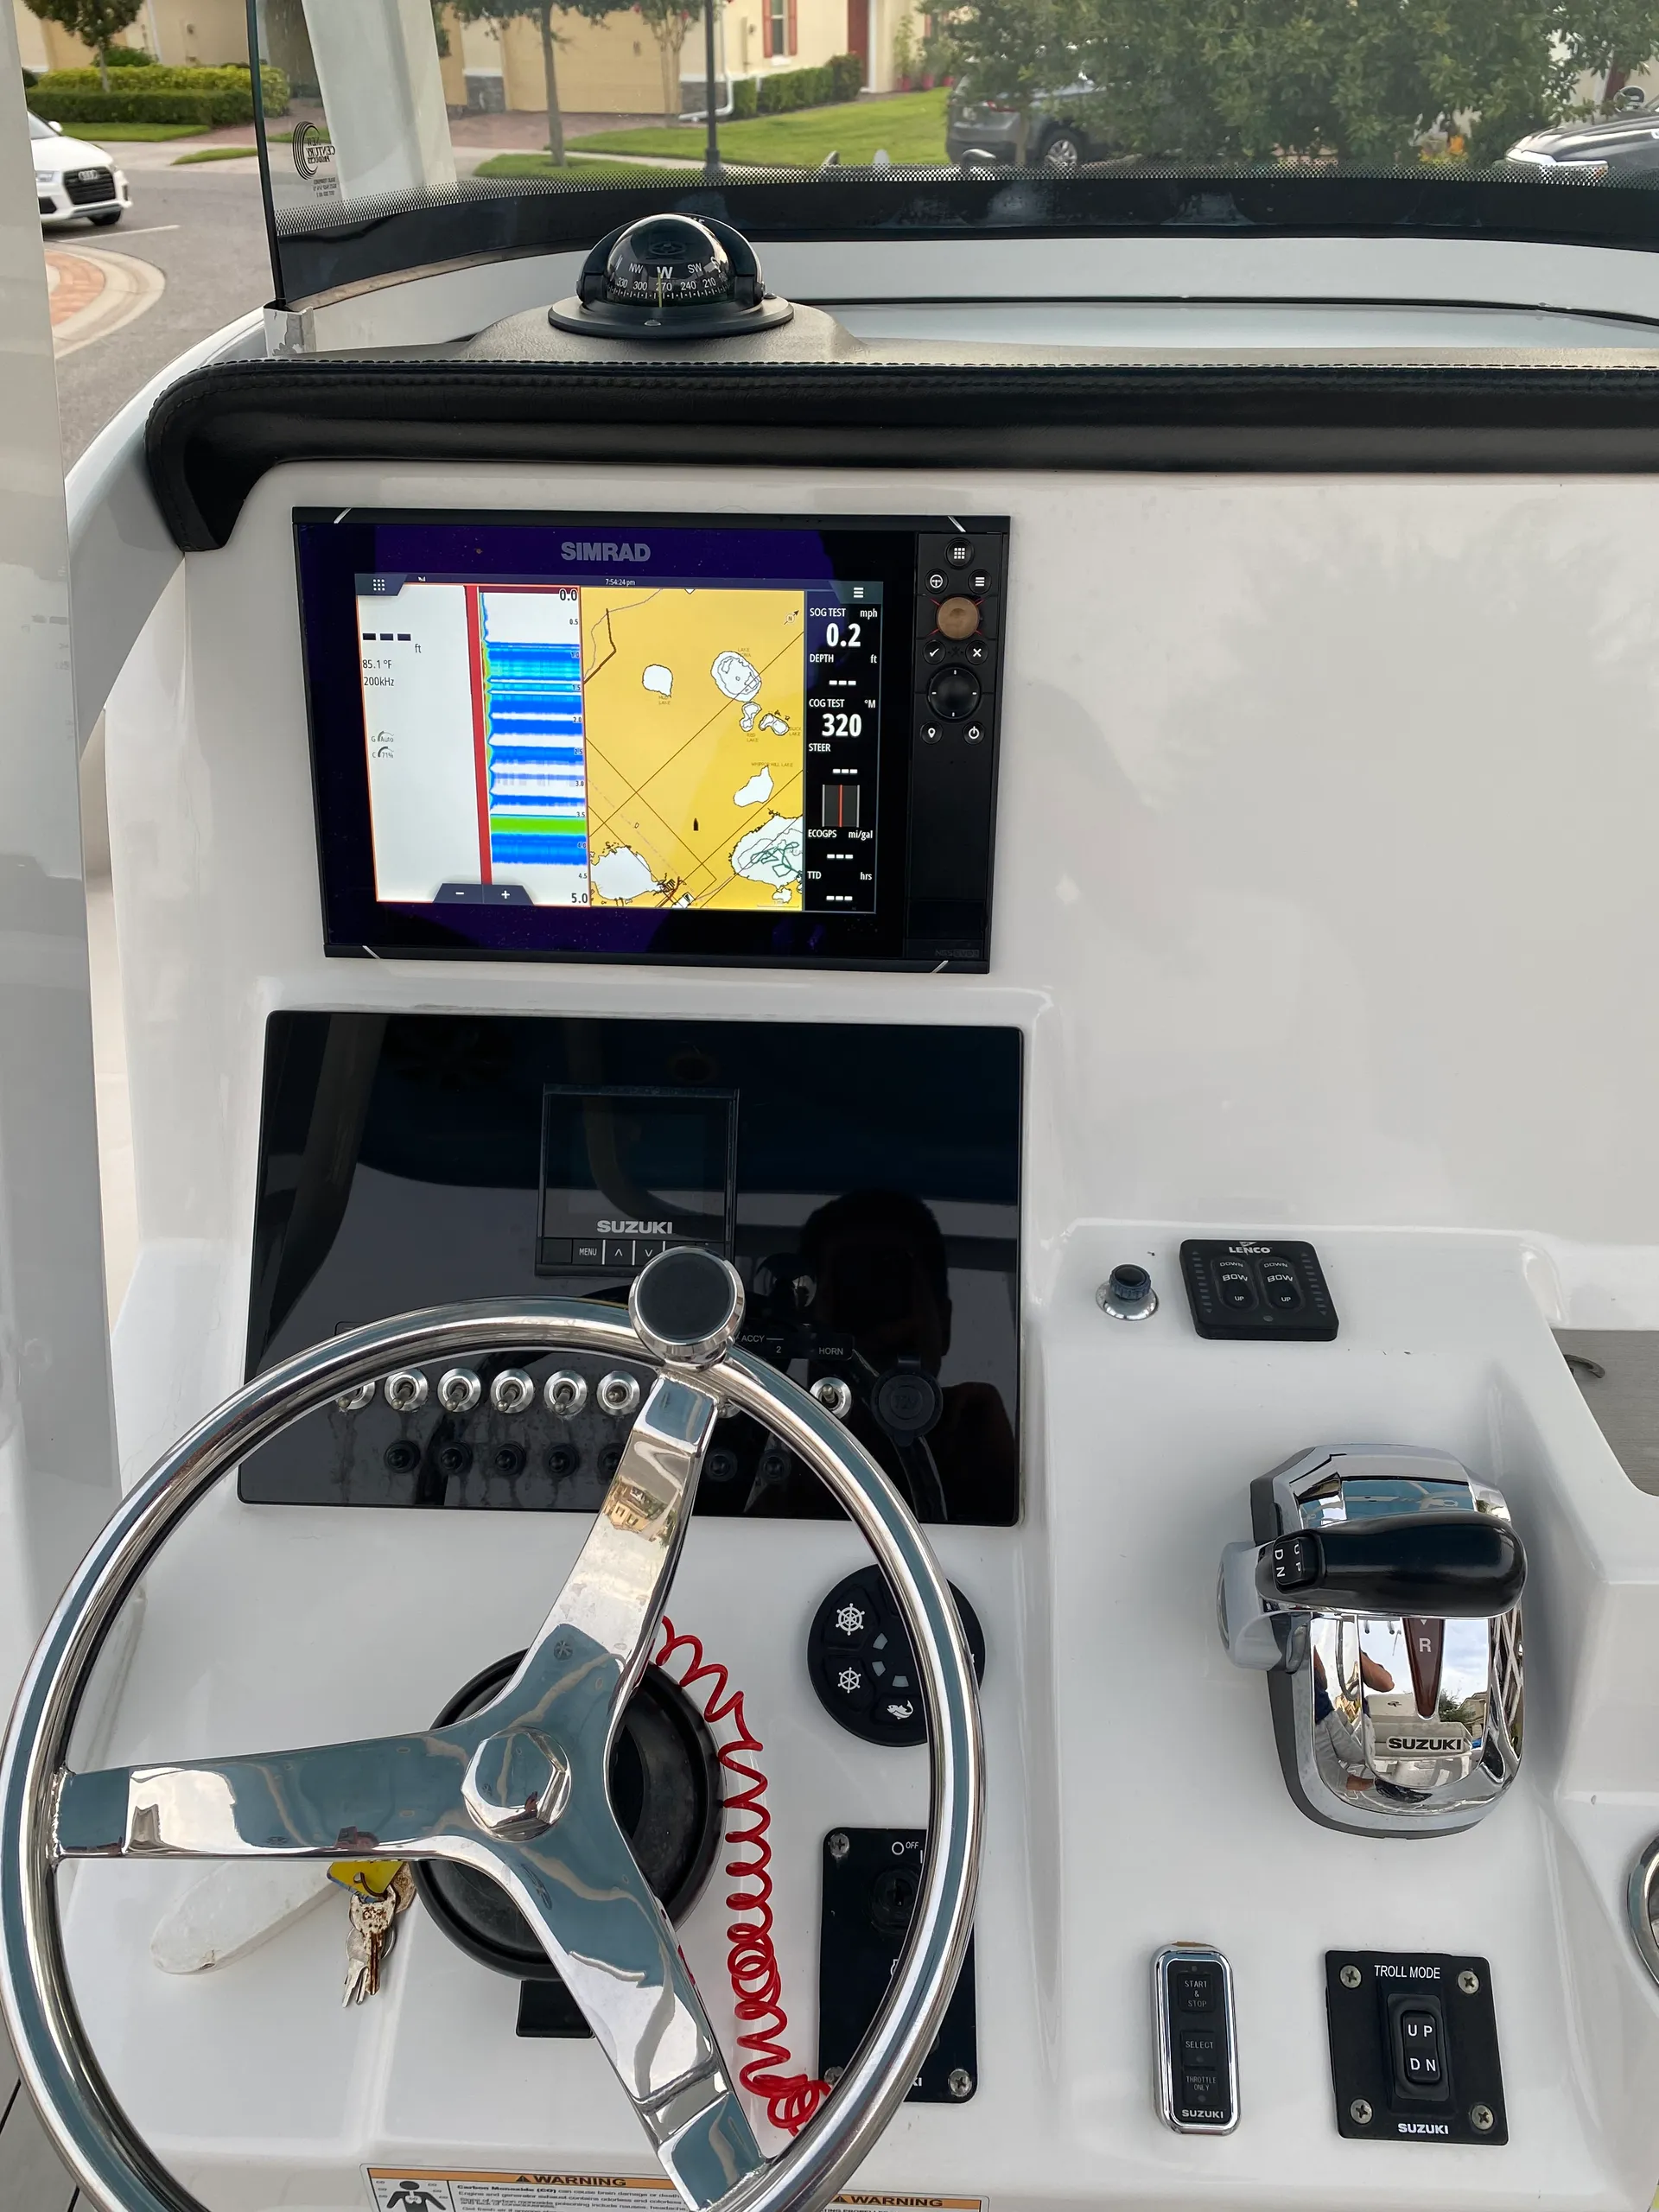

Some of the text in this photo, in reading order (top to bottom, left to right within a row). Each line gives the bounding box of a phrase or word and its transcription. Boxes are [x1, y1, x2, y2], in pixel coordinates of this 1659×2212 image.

[629, 263, 644, 274] NW
[657, 266, 673, 279] W
[687, 263, 702, 274] SW
[632, 281, 648, 291] 300
[655, 282, 673, 291] 270
[680, 281, 697, 291] 240
[702, 277, 716, 289] 210
[561, 541, 652, 562] SIMRAD
[559, 588, 578, 601] 0.0
[810, 607, 847, 618] SOG TEST
[860, 609, 878, 620] mph
[826, 622, 861, 647] 0.2
[415, 643, 422, 654] ft
[810, 653, 835, 664] DEPTH
[870, 654, 878, 664] ft
[362, 659, 392, 670] 85.1 °F
[364, 677, 395, 687] 200kHz
[808, 698, 845, 708] COG TEST
[864, 699, 876, 709] °M
[822, 713, 862, 737] 320
[380, 734, 394, 742] Auto
[809, 743, 831, 752] STEER
[808, 830, 837, 838] ECOGPS
[848, 830, 873, 841] mi/gal
[807, 871, 822, 880] TTD
[860, 872, 873, 880] hrs
[571, 893, 588, 903] 5.0
[596, 1220, 673, 1234] SUZUKI
[579, 1248, 597, 1256] MENU
[1229, 1246, 1271, 1255] LENCO
[1419, 1637, 1432, 1652] R
[1389, 1738, 1461, 1750] SUZUKI
[1374, 1965, 1440, 1980] TROLL MODE
[1185, 2040, 1214, 2049] SELECT
[1185, 2075, 1217, 2084] THROTTLE
[1182, 2109, 1224, 2119] SUZUKI
[1398, 2123, 1449, 2135] SUZUKI
[533, 2175, 626, 2186] WARNING
[850, 2196, 944, 2207] WARNING
